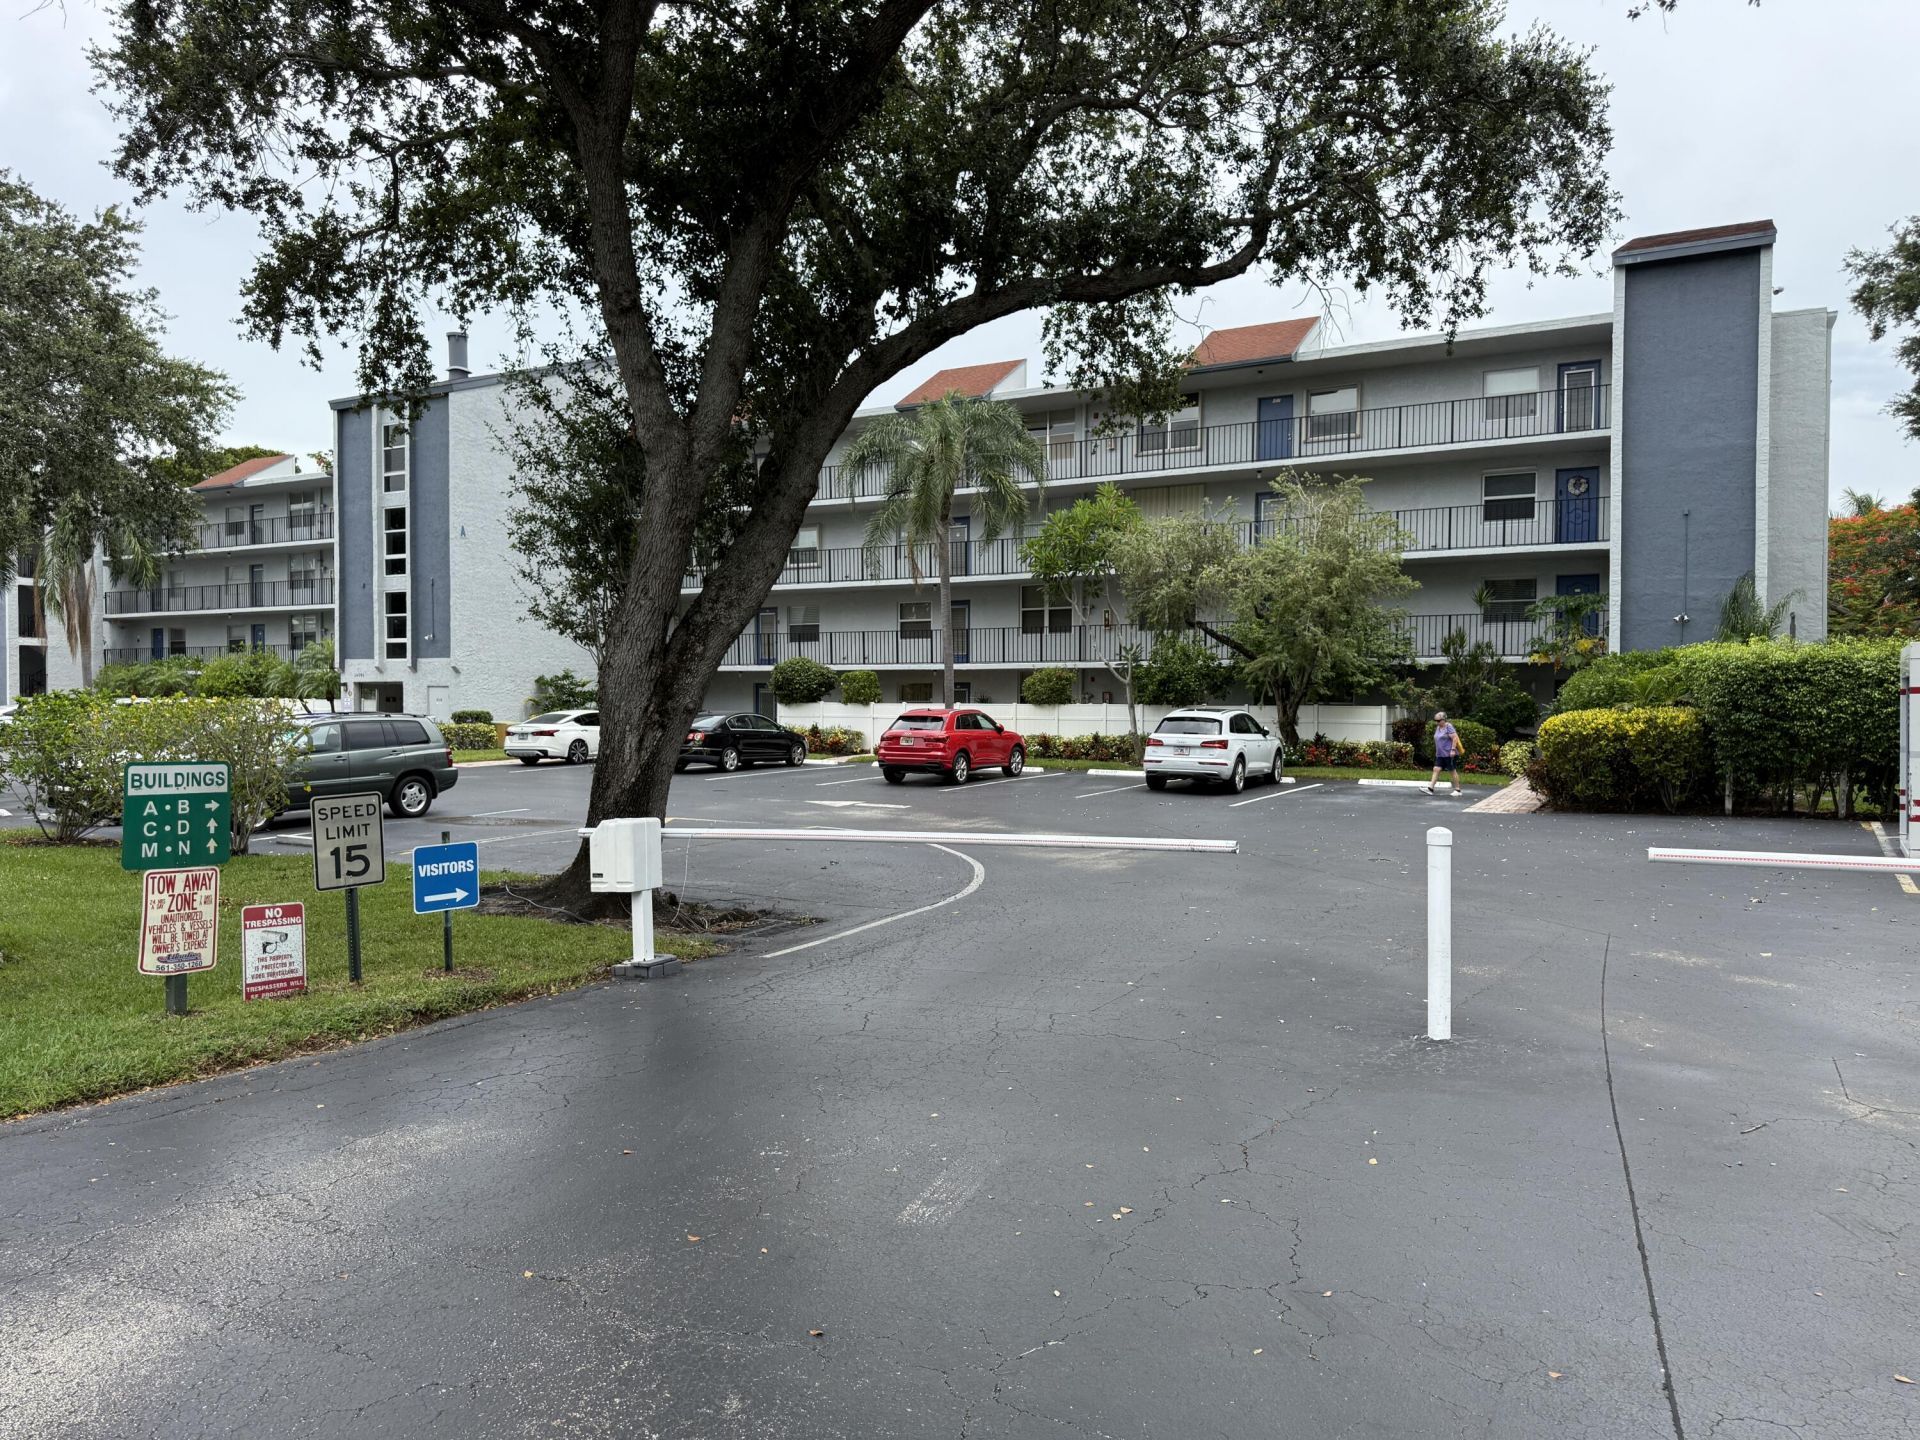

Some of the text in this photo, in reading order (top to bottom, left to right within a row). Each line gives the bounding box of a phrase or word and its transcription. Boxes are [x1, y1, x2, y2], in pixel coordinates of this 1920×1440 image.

[131, 771, 226, 789] BUILDINGS
[143, 799, 190, 817] A B
[318, 803, 377, 821] SPEED
[143, 819, 190, 837] C D
[325, 823, 371, 840] LIMIT
[141, 840, 191, 858] M N
[330, 843, 371, 880] 15
[418, 859, 475, 878] VISITORS
[150, 872, 214, 895] TOW AWAY
[167, 892, 198, 912] ZONE
[161, 911, 203, 924] UNAUTHORIZED
[265, 907, 283, 919] NO
[148, 919, 213, 935] VEHICLES & VESSELS
[245, 916, 302, 929] TRESPASSING
[151, 930, 209, 944] WILL BE TOWED AT
[152, 939, 208, 954] OWNER'S EXPENSE
[246, 979, 304, 992] TRESPASSERS WILL
